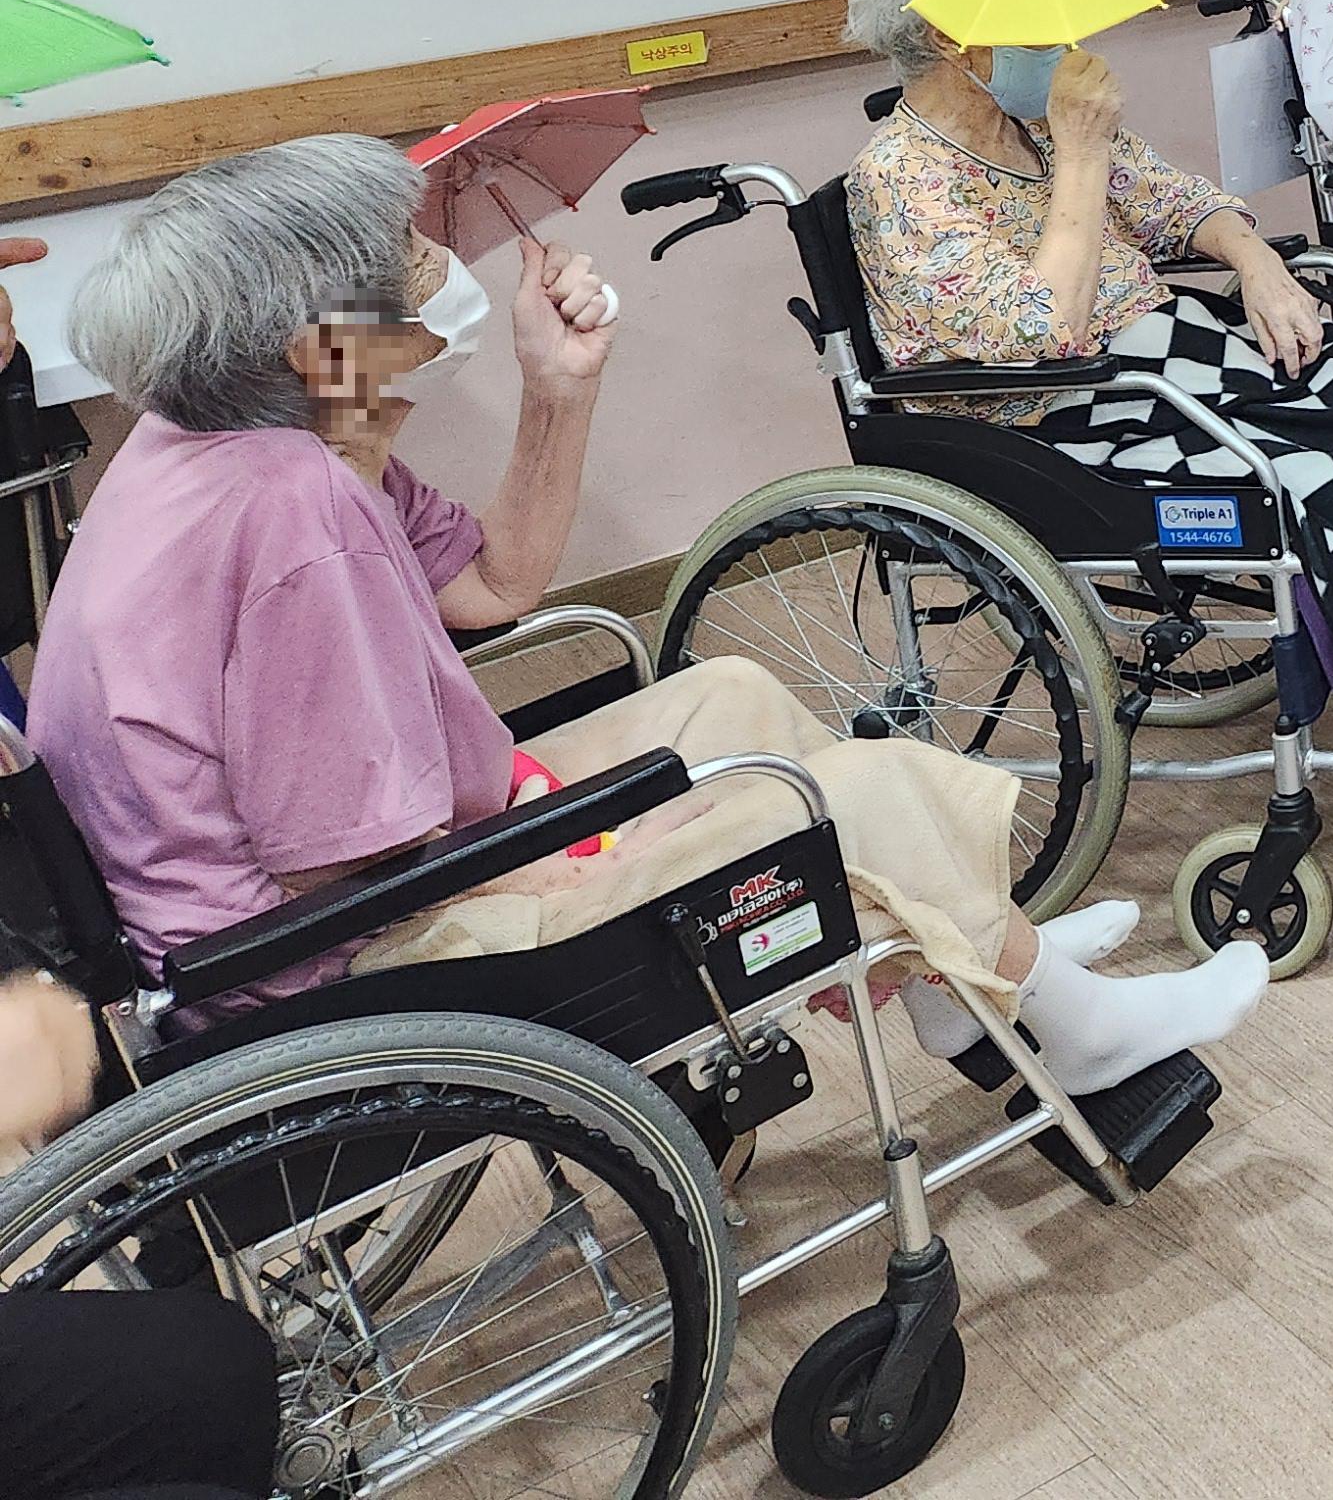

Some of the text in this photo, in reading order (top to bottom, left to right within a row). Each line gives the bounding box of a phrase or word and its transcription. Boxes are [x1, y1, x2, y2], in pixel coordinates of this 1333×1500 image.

[641, 43, 693, 61] 낙상주의
[1182, 507, 1232, 522] Triple A1
[1170, 532, 1232, 543] 1544-4676
[729, 865, 784, 907] MK
[718, 877, 804, 927] 미키코리아(주)
